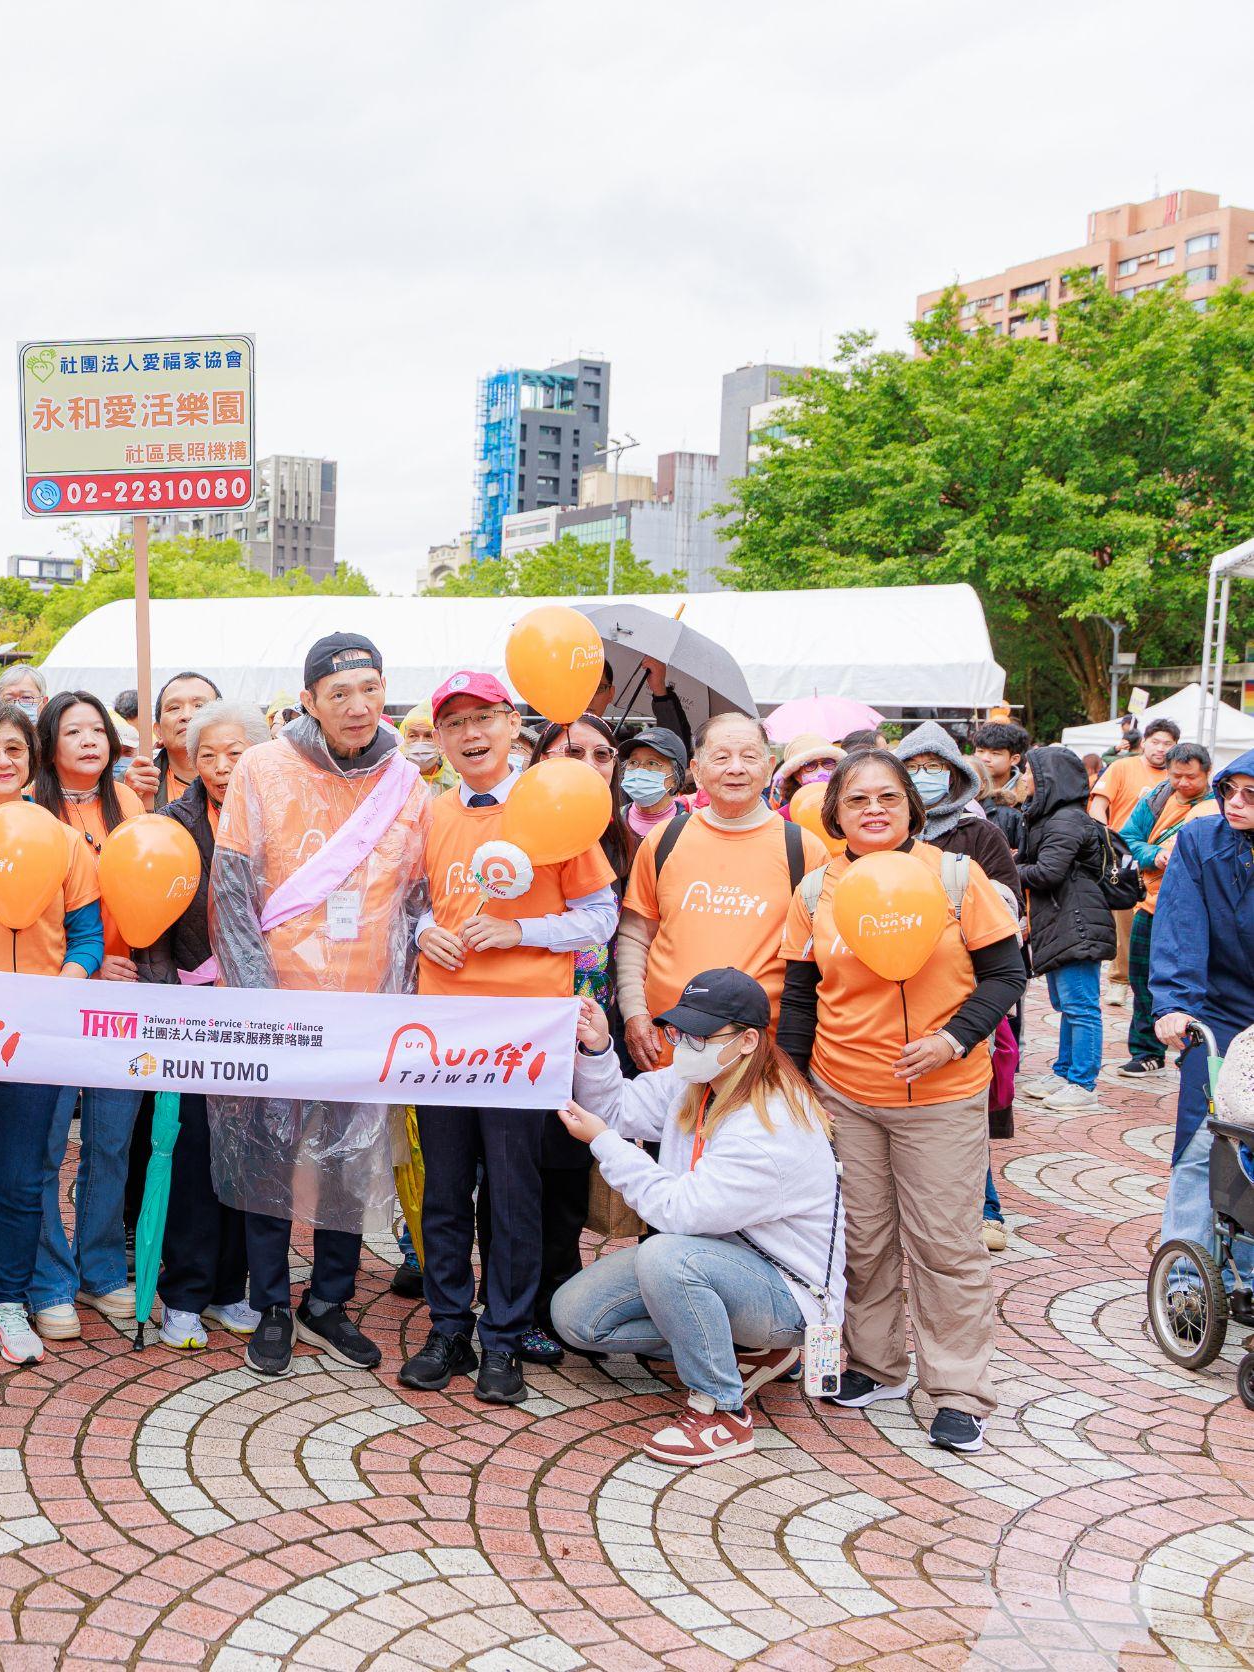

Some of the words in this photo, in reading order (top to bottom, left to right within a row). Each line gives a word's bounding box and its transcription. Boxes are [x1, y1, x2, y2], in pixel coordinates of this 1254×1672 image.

[59, 350, 243, 375] 社團法人愛福家協會
[32, 390, 245, 432] 永和愛活樂園
[125, 440, 247, 465] 社區長照機構
[66, 476, 246, 504] 02-22310080
[144, 1015, 177, 1025] Taiwan
[179, 1017, 206, 1027] Home
[208, 1018, 242, 1029] Service
[244, 1020, 285, 1032] Strategic
[287, 1022, 324, 1032] Alliance
[142, 1026, 323, 1047] 社團法人台灣居家服務策略聯盟
[162, 1059, 204, 1079] RUN
[211, 1061, 269, 1081] TOMO
[399, 1069, 496, 1084] Taiwan
